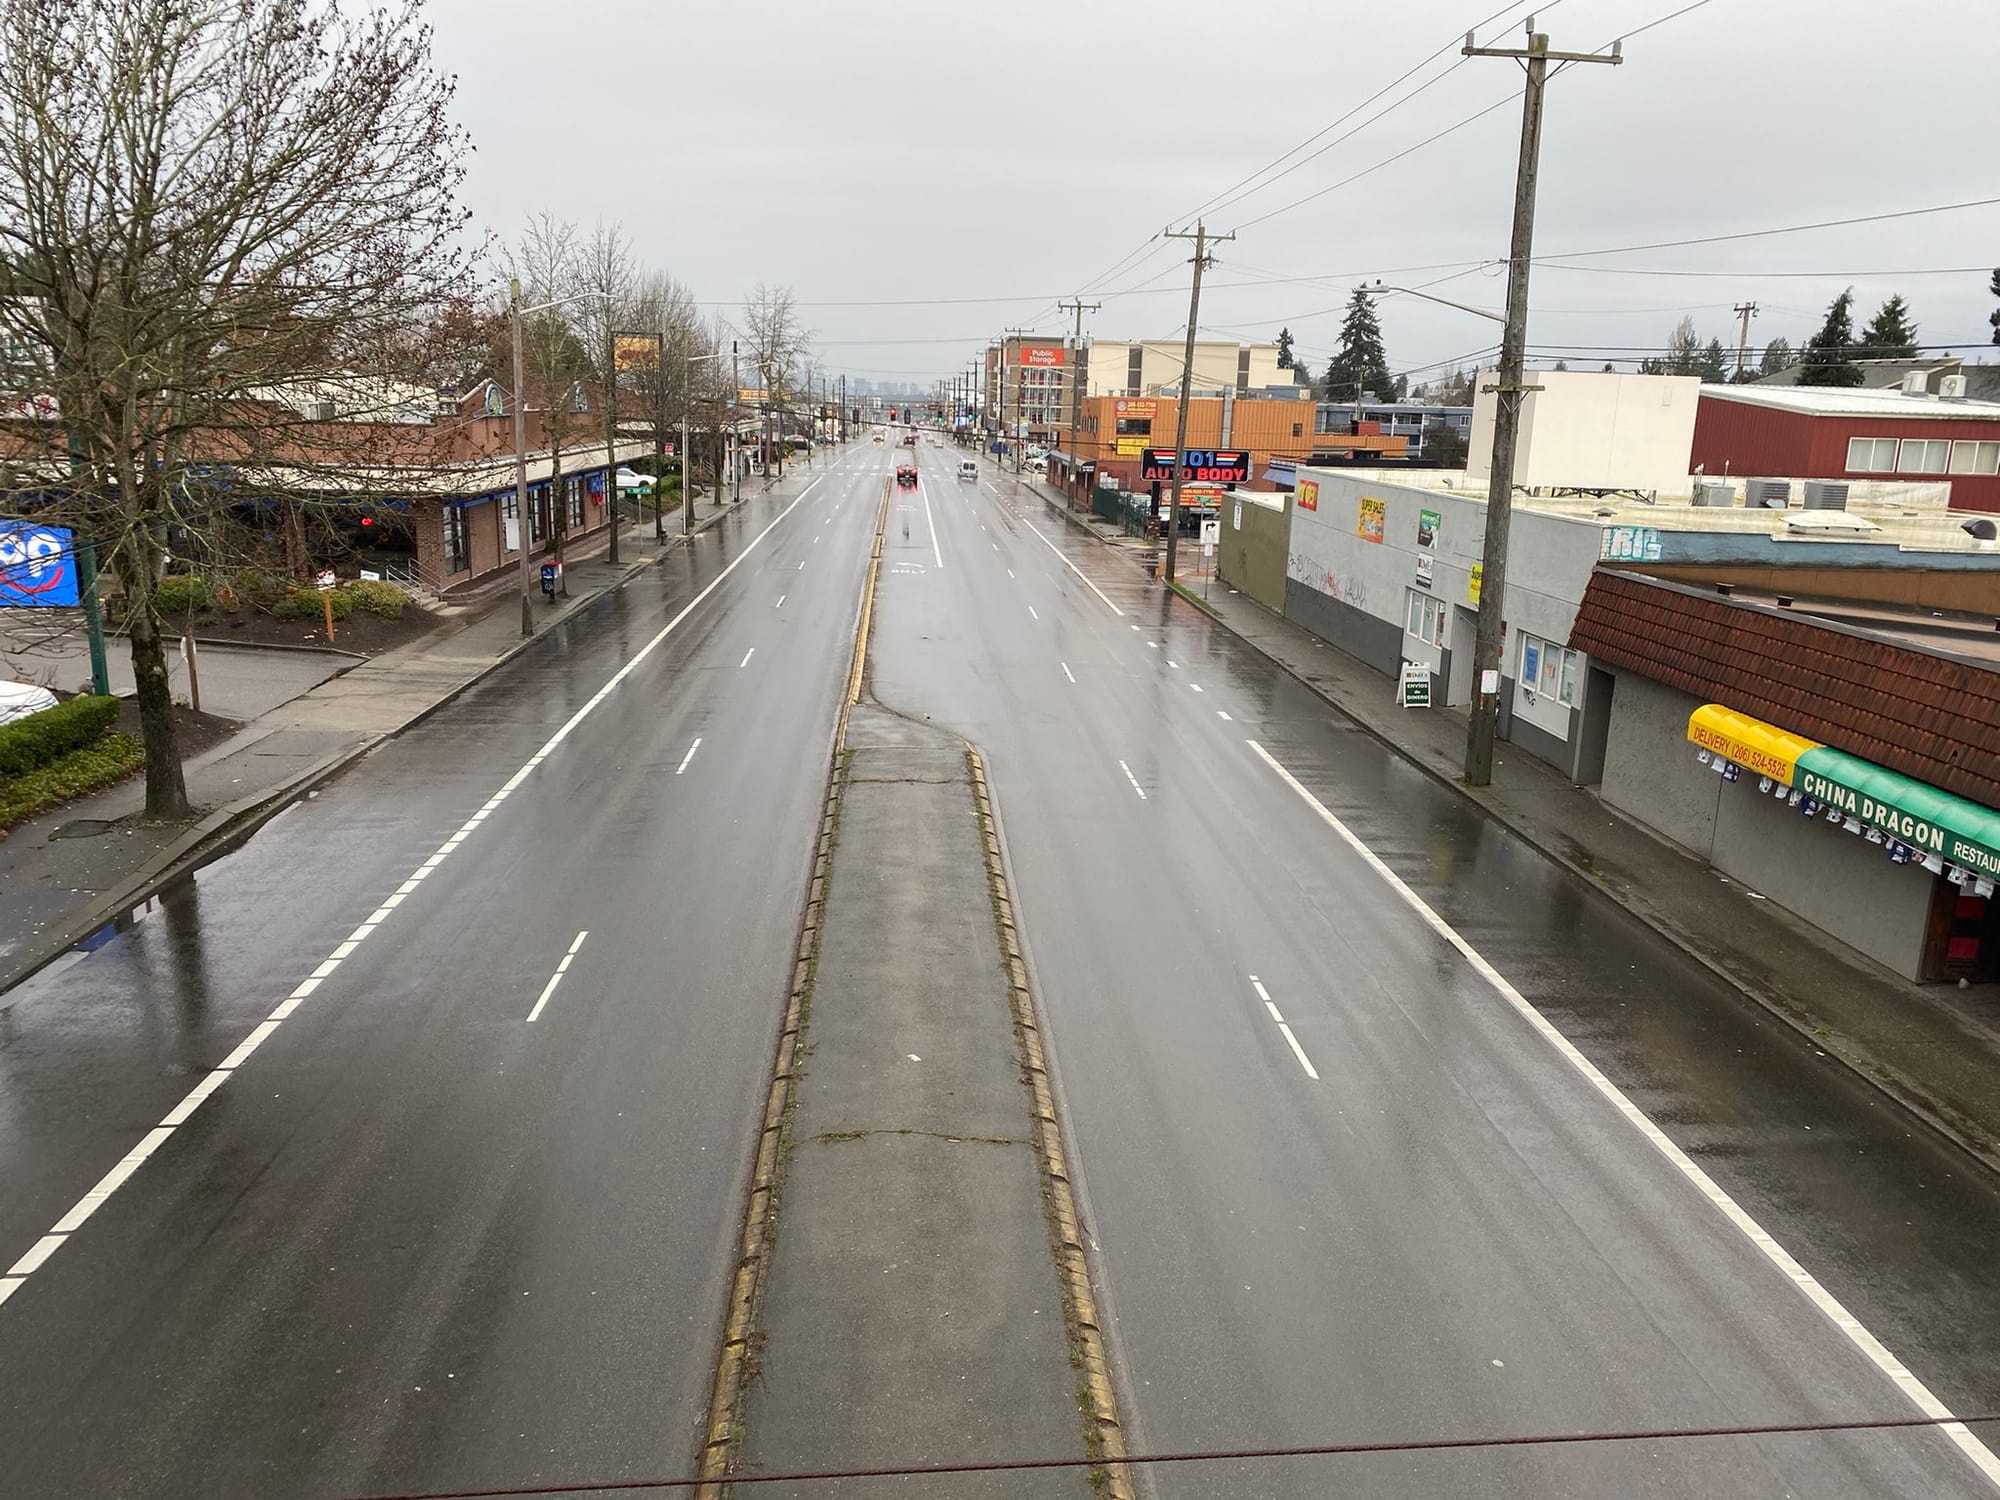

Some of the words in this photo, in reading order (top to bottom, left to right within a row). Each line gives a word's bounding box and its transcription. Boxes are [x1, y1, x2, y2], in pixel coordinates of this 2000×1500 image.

[1028, 356, 1057, 365] Storage
[1031, 349, 1055, 357] Public
[1182, 450, 1215, 467] 101
[1196, 467, 1246, 481] BODY
[1693, 726, 1731, 753] DELIVERY
[1732, 743, 1750, 764] (206)
[1750, 751, 1787, 778] 524-5525
[1803, 773, 1857, 813] CHINA
[1861, 798, 1945, 851] DRAGON
